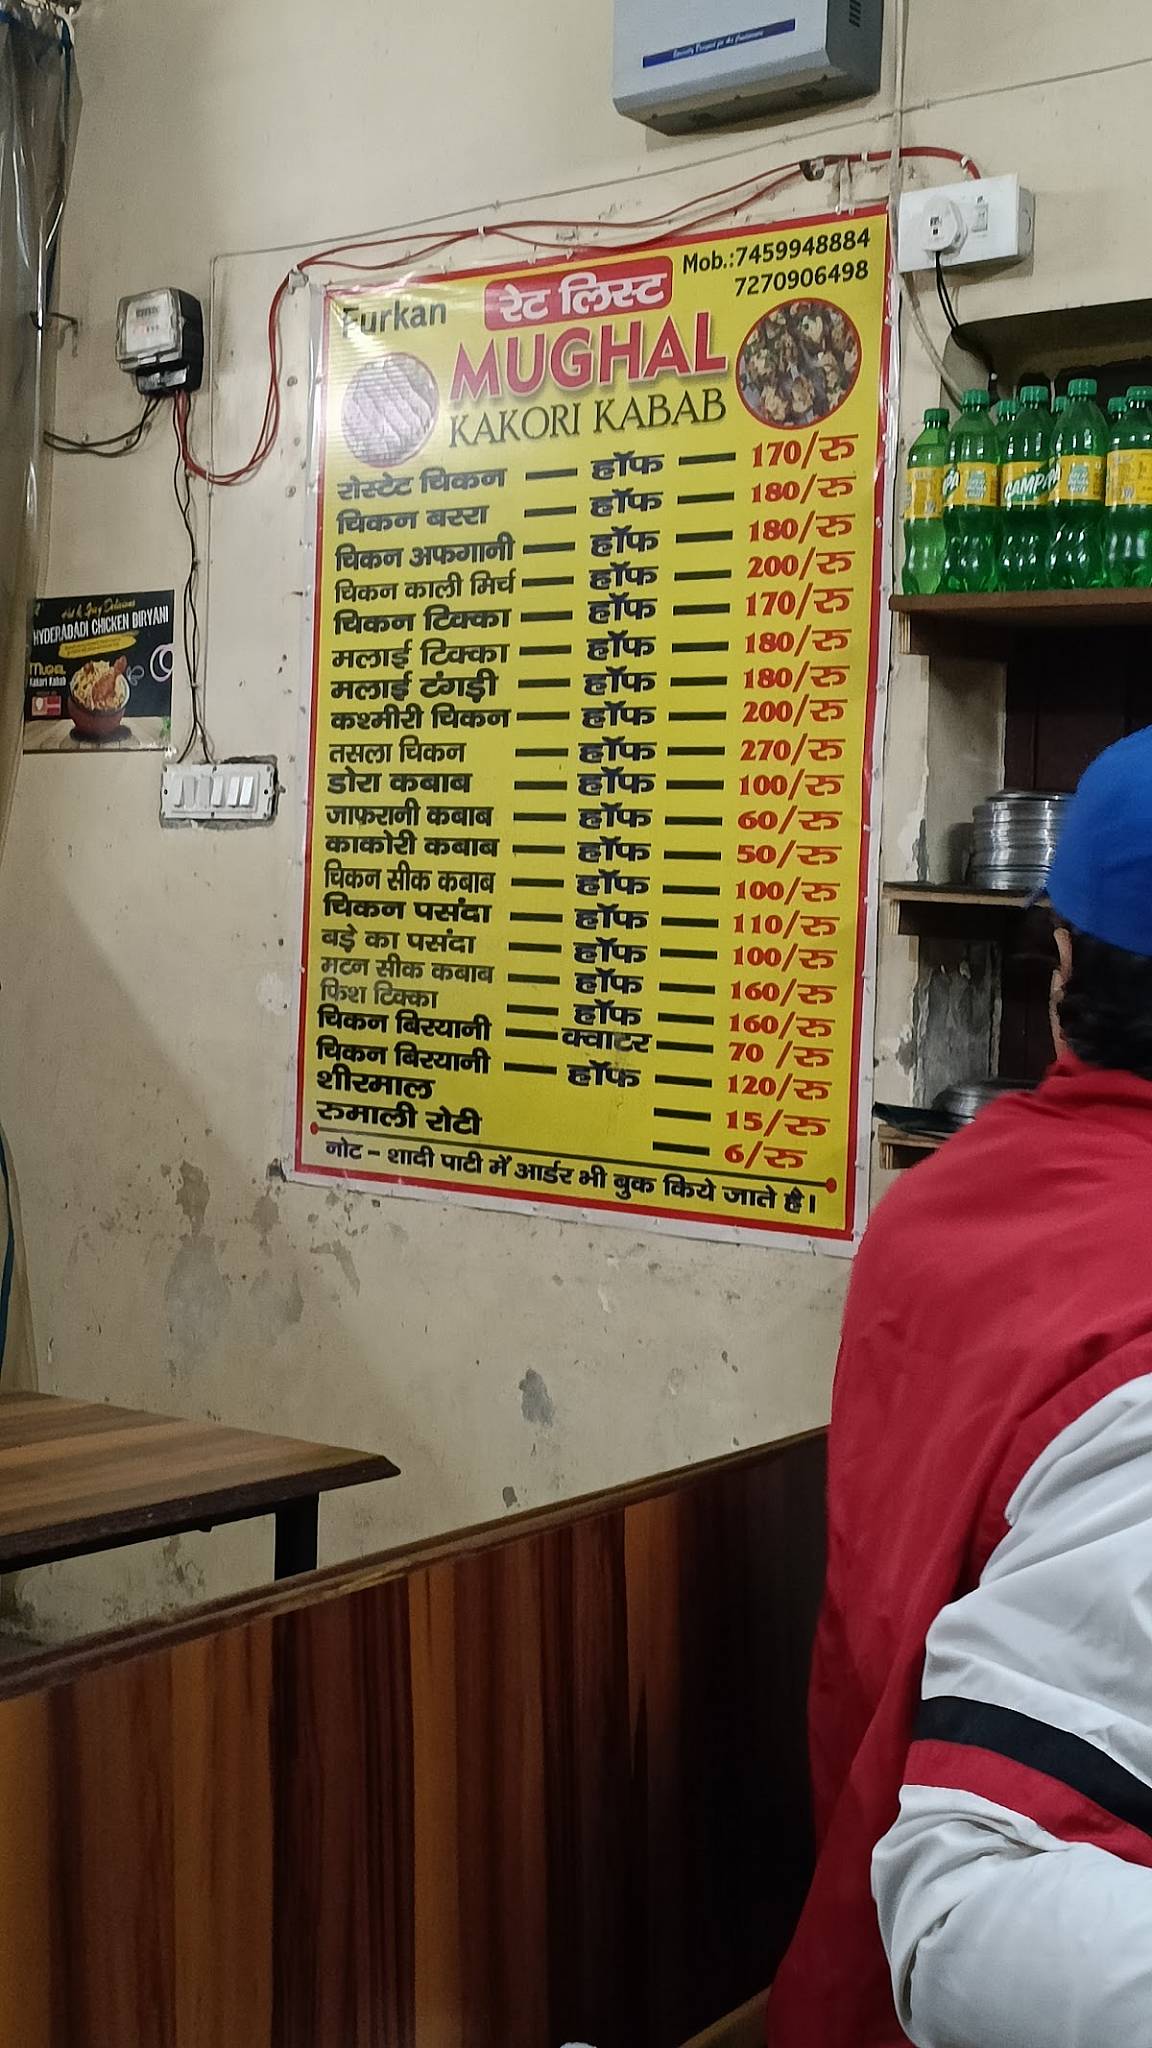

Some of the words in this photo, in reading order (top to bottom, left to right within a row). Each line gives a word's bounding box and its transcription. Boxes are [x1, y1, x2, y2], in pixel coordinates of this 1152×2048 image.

[682, 230, 871, 274] Mob.:7459948884
[499, 285, 549, 324] रेट
[562, 271, 668, 313] लिस्ट
[735, 260, 868, 296] 7270906498
[343, 301, 446, 337] Furkan
[450, 311, 728, 404] MUGHAL
[450, 402, 581, 447] KAKORI
[593, 388, 726, 433] KABAB
[419, 467, 508, 494] चिकन
[590, 450, 665, 480] हॉफ
[336, 509, 419, 535] चिकन
[589, 487, 664, 517] हॉफ
[335, 543, 404, 572] चिकन
[409, 531, 516, 567] अफगानी
[590, 525, 660, 557] हॉफ
[335, 579, 399, 604] चिकन
[404, 572, 464, 599] काली
[470, 568, 516, 596] मिर्च
[589, 561, 659, 590] हॉफ
[33, 621, 88, 646] HYDERABADI
[92, 615, 129, 636] CHICKEN
[132, 606, 168, 628] BIRYANI
[333, 609, 416, 635] चिकन
[423, 604, 512, 631] टिक्का
[587, 592, 658, 624] हॉफ
[332, 639, 413, 669] मलाई
[420, 638, 510, 666] टिक्का
[586, 630, 656, 661] हॉफ
[330, 670, 413, 701] मलाई
[583, 665, 657, 696] हॉफ
[331, 703, 424, 730] कश्मीरी
[431, 702, 512, 729] चिकन
[581, 700, 657, 728] हॉफ
[329, 744, 393, 764] तसला
[399, 735, 467, 763] चिकन
[578, 736, 657, 764] हॉफ
[327, 765, 382, 794] डोरा
[389, 773, 473, 793] कबाब
[577, 766, 656, 796] हॉफ
[426, 806, 494, 827] कबाब
[578, 802, 653, 829] हॉफ
[325, 829, 418, 855] काकोरी
[424, 837, 500, 857] कबाब
[577, 836, 651, 863] हॉफ
[324, 858, 382, 890] चिकन
[387, 860, 433, 891] सीक
[437, 871, 496, 894] कबाब
[575, 868, 650, 896] हॉफ
[323, 891, 407, 919] चिकन
[413, 897, 492, 923] पसंदा
[574, 903, 649, 930] हॉफ
[321, 923, 358, 953] बड़े
[364, 931, 400, 949] का
[406, 928, 476, 954] पसंदा
[573, 937, 648, 964] हॉफ
[321, 956, 370, 976] मटन
[375, 953, 425, 979] सीक
[431, 962, 495, 984] कबाब
[574, 967, 644, 994] हॉफ
[320, 977, 367, 1004] फिश
[374, 980, 439, 1009] टिक्का
[573, 999, 642, 1026] हॉफ
[317, 1003, 389, 1033] चिकन
[729, 1042, 764, 1063] 70
[316, 1035, 388, 1065] चिकन
[567, 1059, 641, 1088] हॉफ
[317, 1063, 436, 1099] शीरमाल
[316, 1100, 418, 1128] रुमाली
[425, 1105, 483, 1135] रोटी
[326, 1137, 363, 1159] नोट
[388, 1145, 435, 1168] शादी
[514, 1160, 575, 1185] आर्डर
[579, 1164, 608, 1188] भी
[613, 1173, 657, 1200] बुक
[663, 1173, 716, 1202] किये
[722, 1184, 778, 1209] जाते
